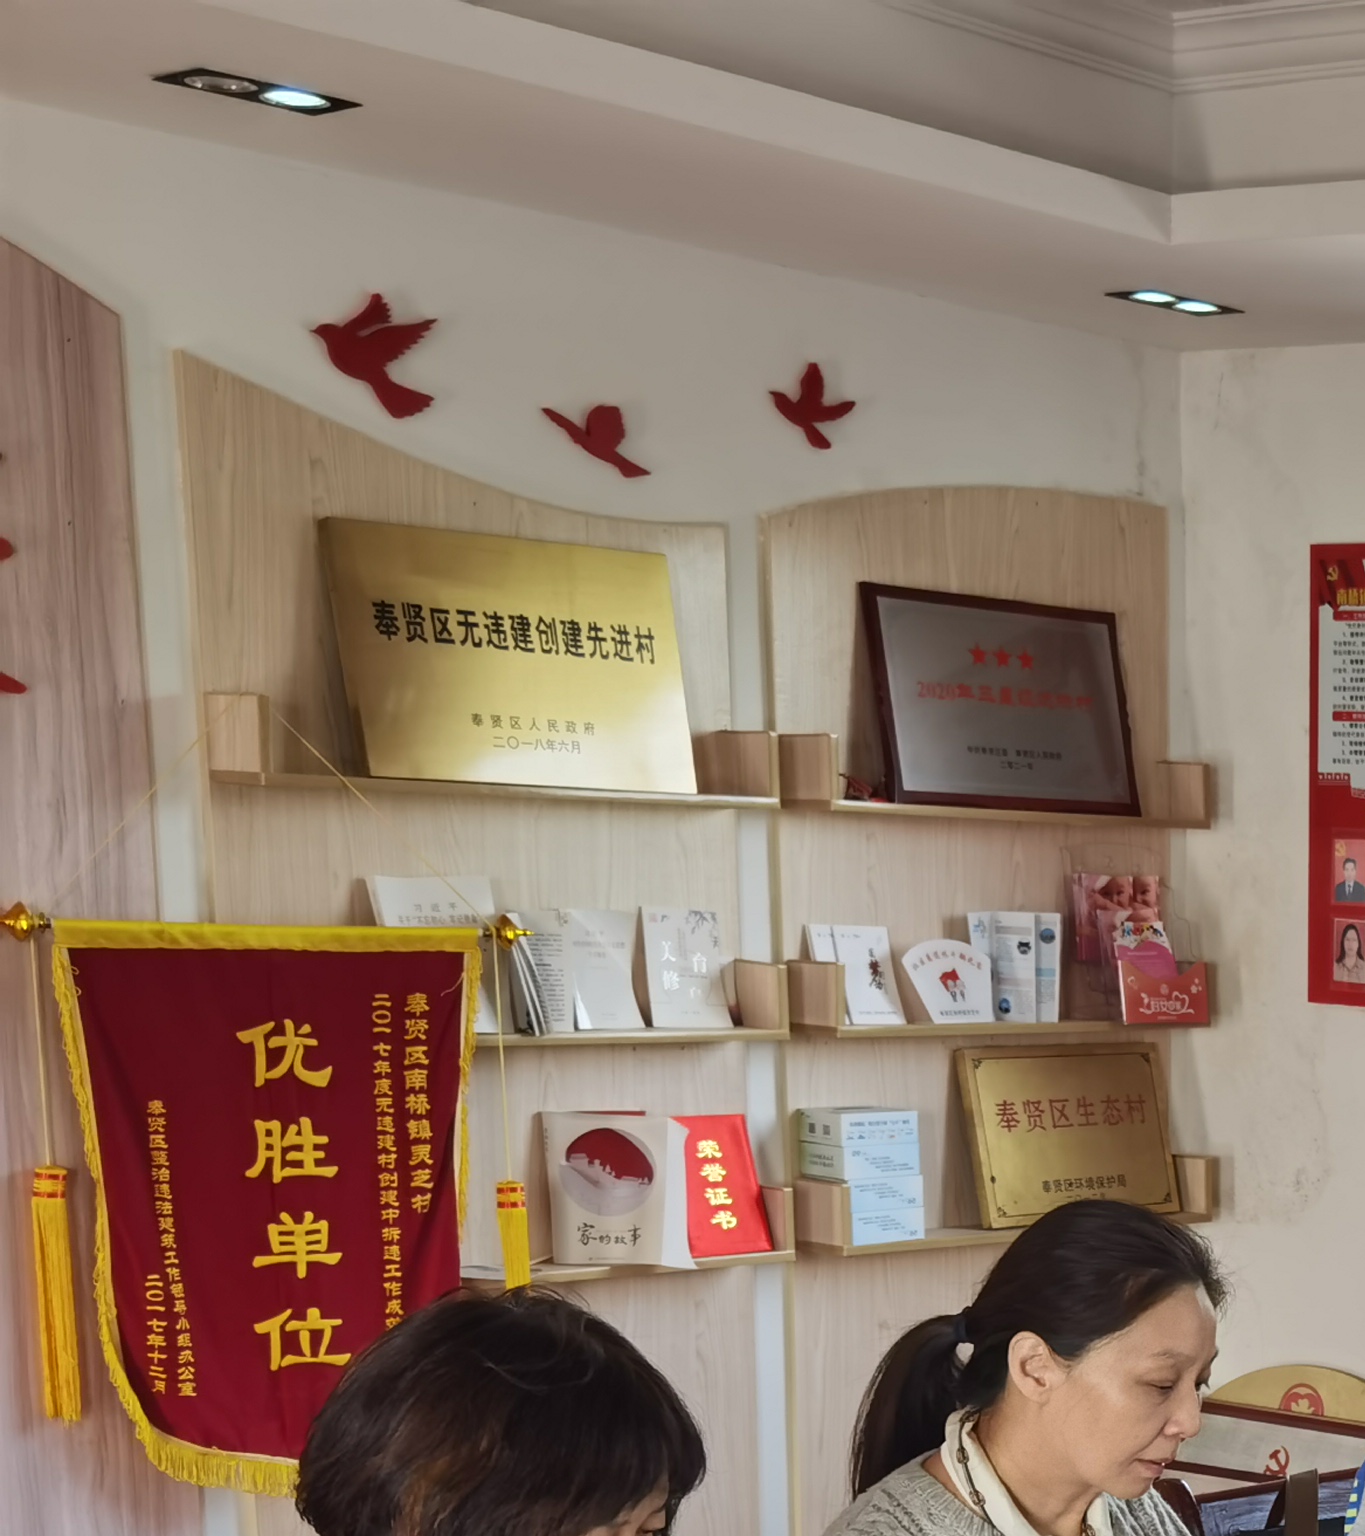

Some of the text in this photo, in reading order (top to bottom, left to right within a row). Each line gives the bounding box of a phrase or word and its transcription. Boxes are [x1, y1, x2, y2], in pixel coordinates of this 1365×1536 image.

[371, 598, 656, 666] 奉贤区无违建创建先进村
[470, 712, 597, 737] 奉贤区人民政府
[403, 992, 435, 1214] 奉贤区南桥镇灵芝村
[994, 1093, 1147, 1134] 奉贤区生态村
[236, 1018, 351, 1372] 优胜单位
[695, 1139, 738, 1231] 荣誉证书
[1042, 1173, 1128, 1194] 奉贤区环境保护局
[146, 1099, 198, 1397] 奉贤区整治违法建筑工作领导小组办公室
[575, 1220, 643, 1248] 家的故事
